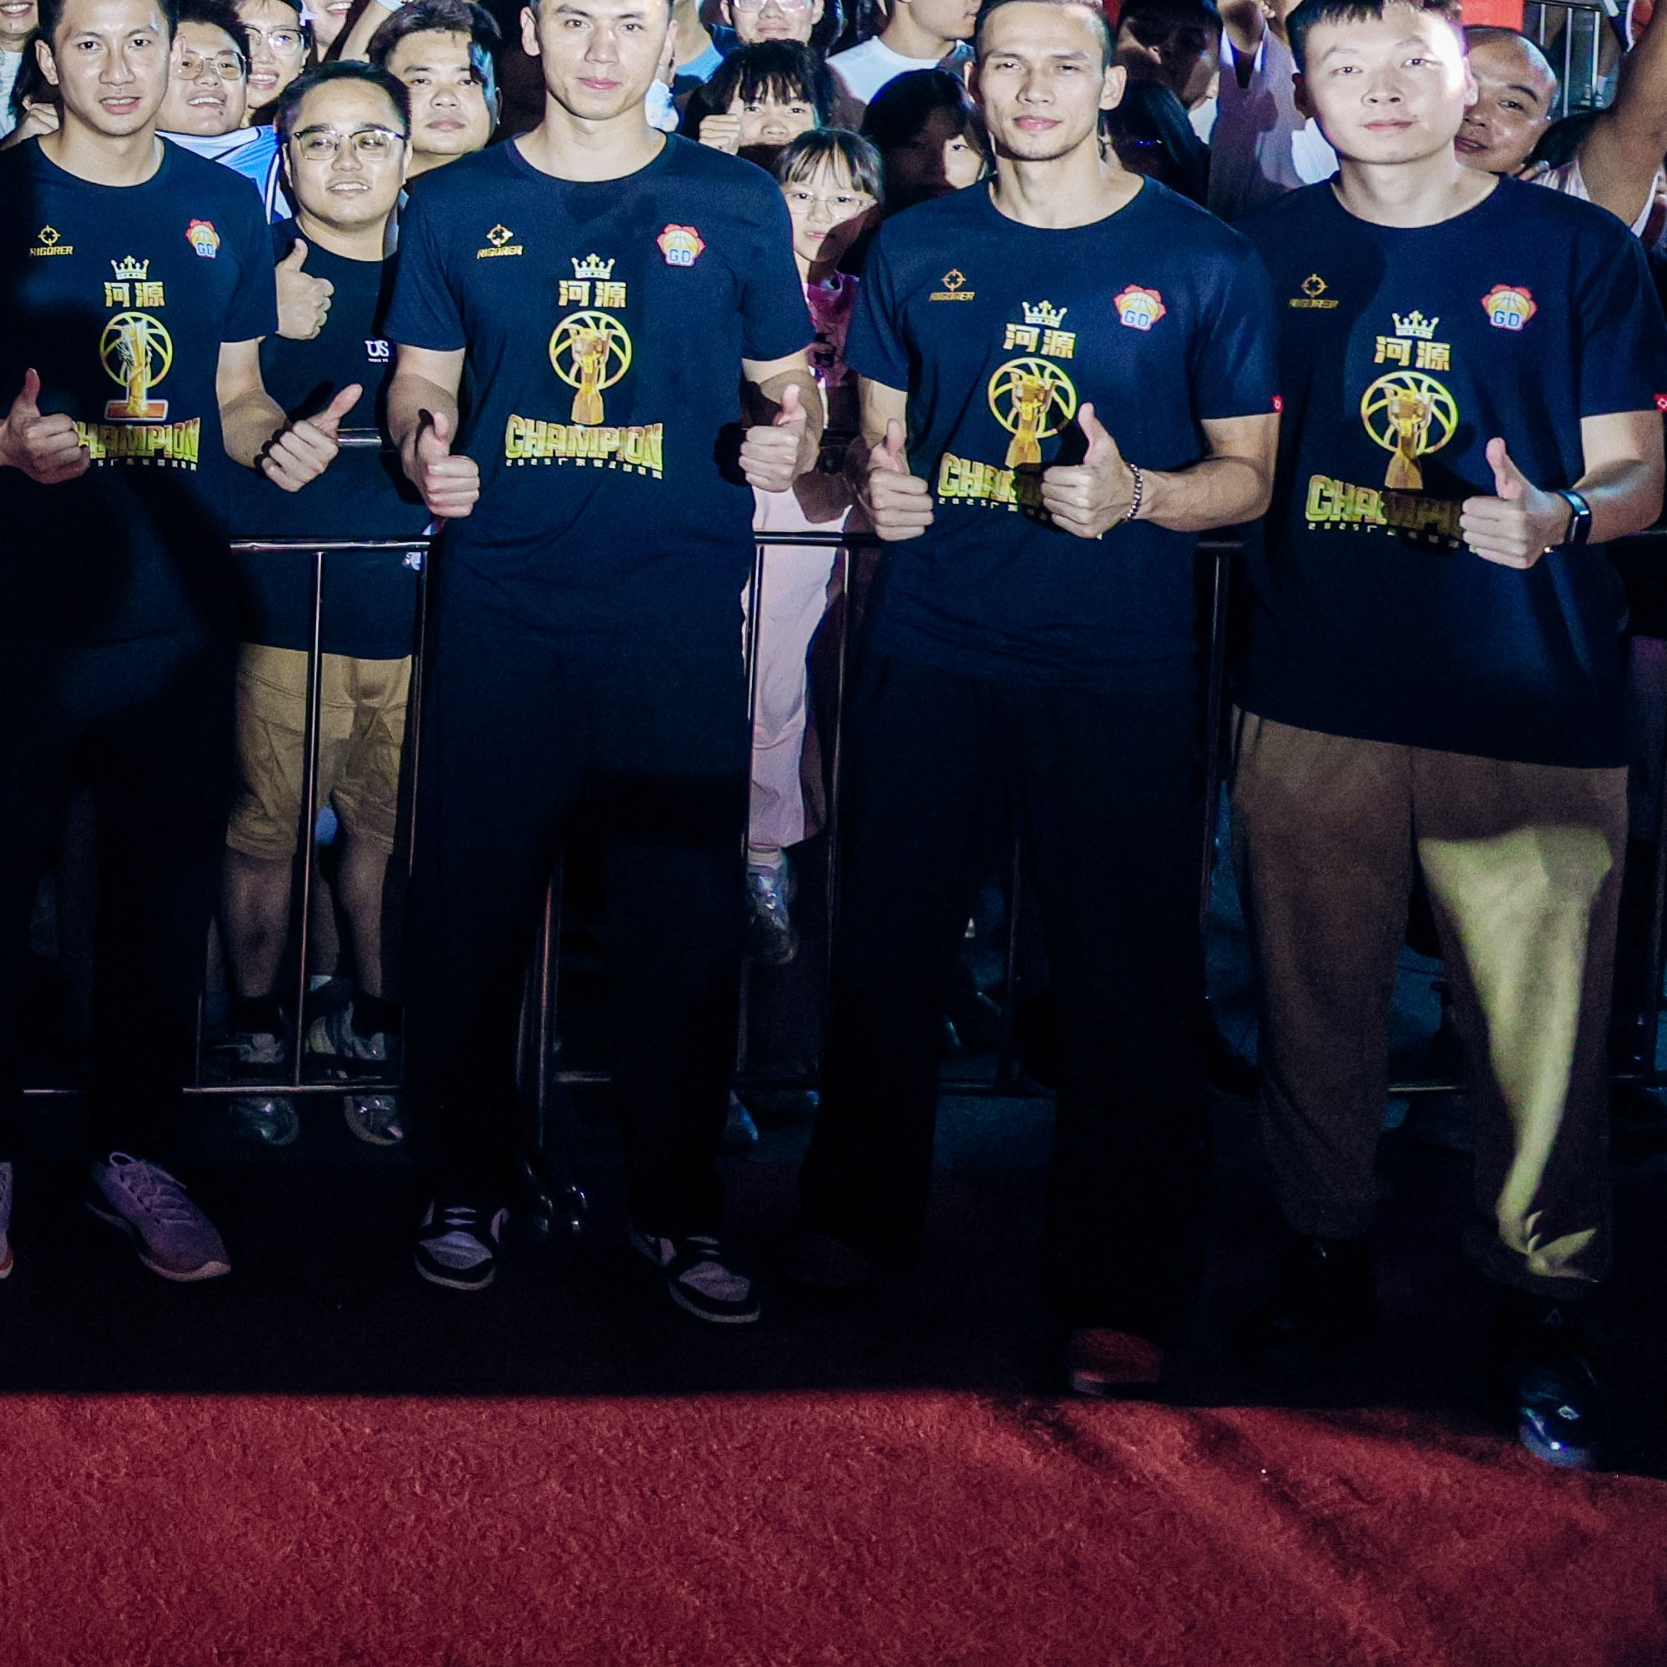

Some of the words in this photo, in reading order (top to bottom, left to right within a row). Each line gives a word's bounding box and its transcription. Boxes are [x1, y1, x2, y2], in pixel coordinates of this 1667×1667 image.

[28, 245, 74, 258] RIGORER
[196, 241, 215, 258] GD
[476, 245, 524, 260] RIGORER
[668, 247, 693, 265] GD
[104, 281, 166, 308] 河源
[557, 280, 628, 309] 河源
[1123, 309, 1151, 329] GD
[1492, 309, 1521, 329] GD
[1003, 322, 1077, 360] 河源
[1373, 335, 1452, 372] 河源
[73, 417, 201, 463] HAMPION
[504, 414, 665, 473] CHAMPION
